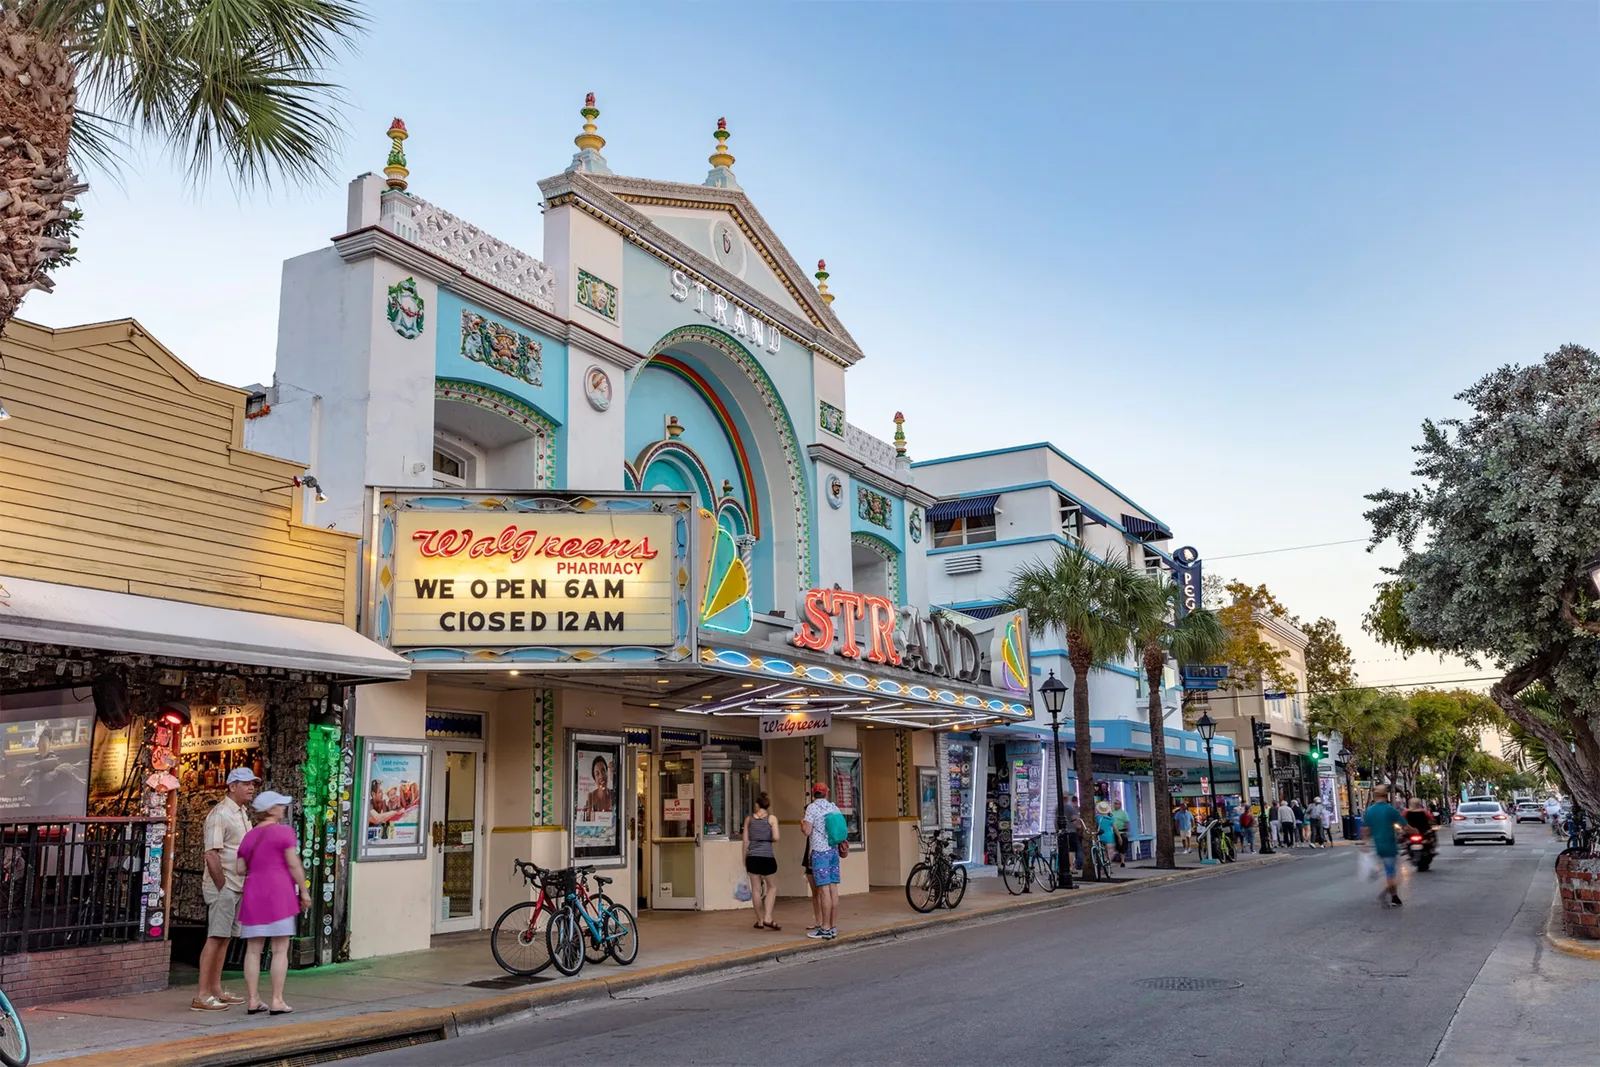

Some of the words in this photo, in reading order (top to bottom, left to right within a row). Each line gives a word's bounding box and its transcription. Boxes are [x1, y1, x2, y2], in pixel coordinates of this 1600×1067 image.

[671, 269, 781, 355] STRAND
[412, 526, 659, 563] Walgreens
[557, 562, 643, 575] PHARMACY
[414, 579, 455, 599] WE
[470, 579, 547, 599] OPEN
[564, 579, 625, 598] 6AM
[791, 588, 981, 683] STRAND
[1191, 667, 1224, 678] HOTEL
[763, 718, 829, 736] Walgreens
